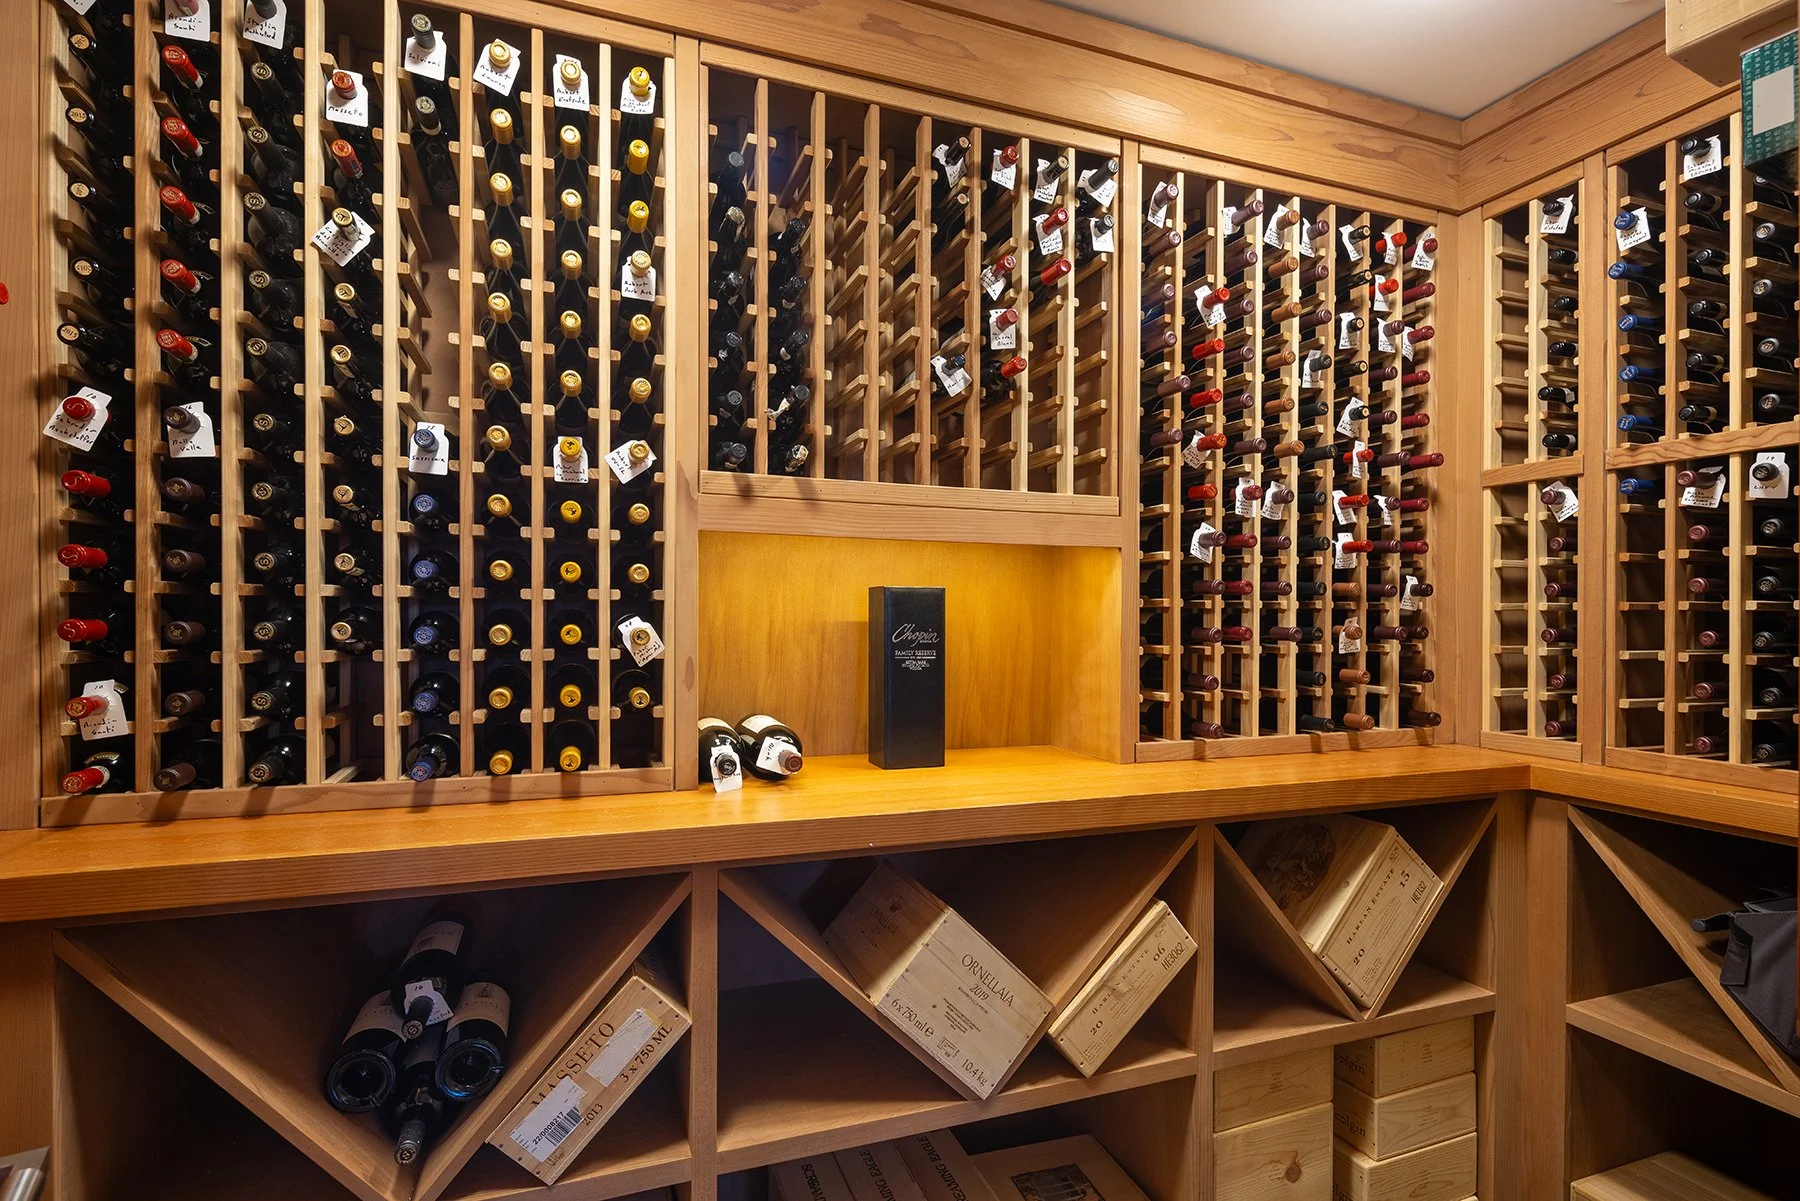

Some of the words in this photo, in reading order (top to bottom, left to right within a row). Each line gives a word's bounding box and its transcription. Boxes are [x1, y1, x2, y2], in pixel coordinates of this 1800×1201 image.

[892, 623, 941, 647] Chopin
[1346, 906, 1373, 945] HARLAN
[1372, 867, 1397, 906] ESTATE
[1160, 942, 1185, 972] HE3062
[1353, 947, 1366, 966] 20
[961, 953, 1017, 1008] ORNELLAIA
[969, 984, 989, 1002] 2019
[1089, 1019, 1103, 1037] 20
[1152, 944, 1166, 962] 06
[1090, 981, 1123, 1015] HARLAN
[1120, 948, 1152, 984] ESTATE
[531, 1021, 616, 1108] MASSETO
[620, 1072, 631, 1083] 3
[636, 1043, 656, 1066] 750
[652, 1023, 673, 1046] ML
[1334, 1053, 1365, 1075] colgin
[961, 1058, 979, 1078] 10.4
[582, 1102, 604, 1126] 2013
[1335, 1112, 1366, 1137] colgin
[918, 1135, 942, 1164] EAGLE
[859, 1150, 882, 1178] EAGLE
